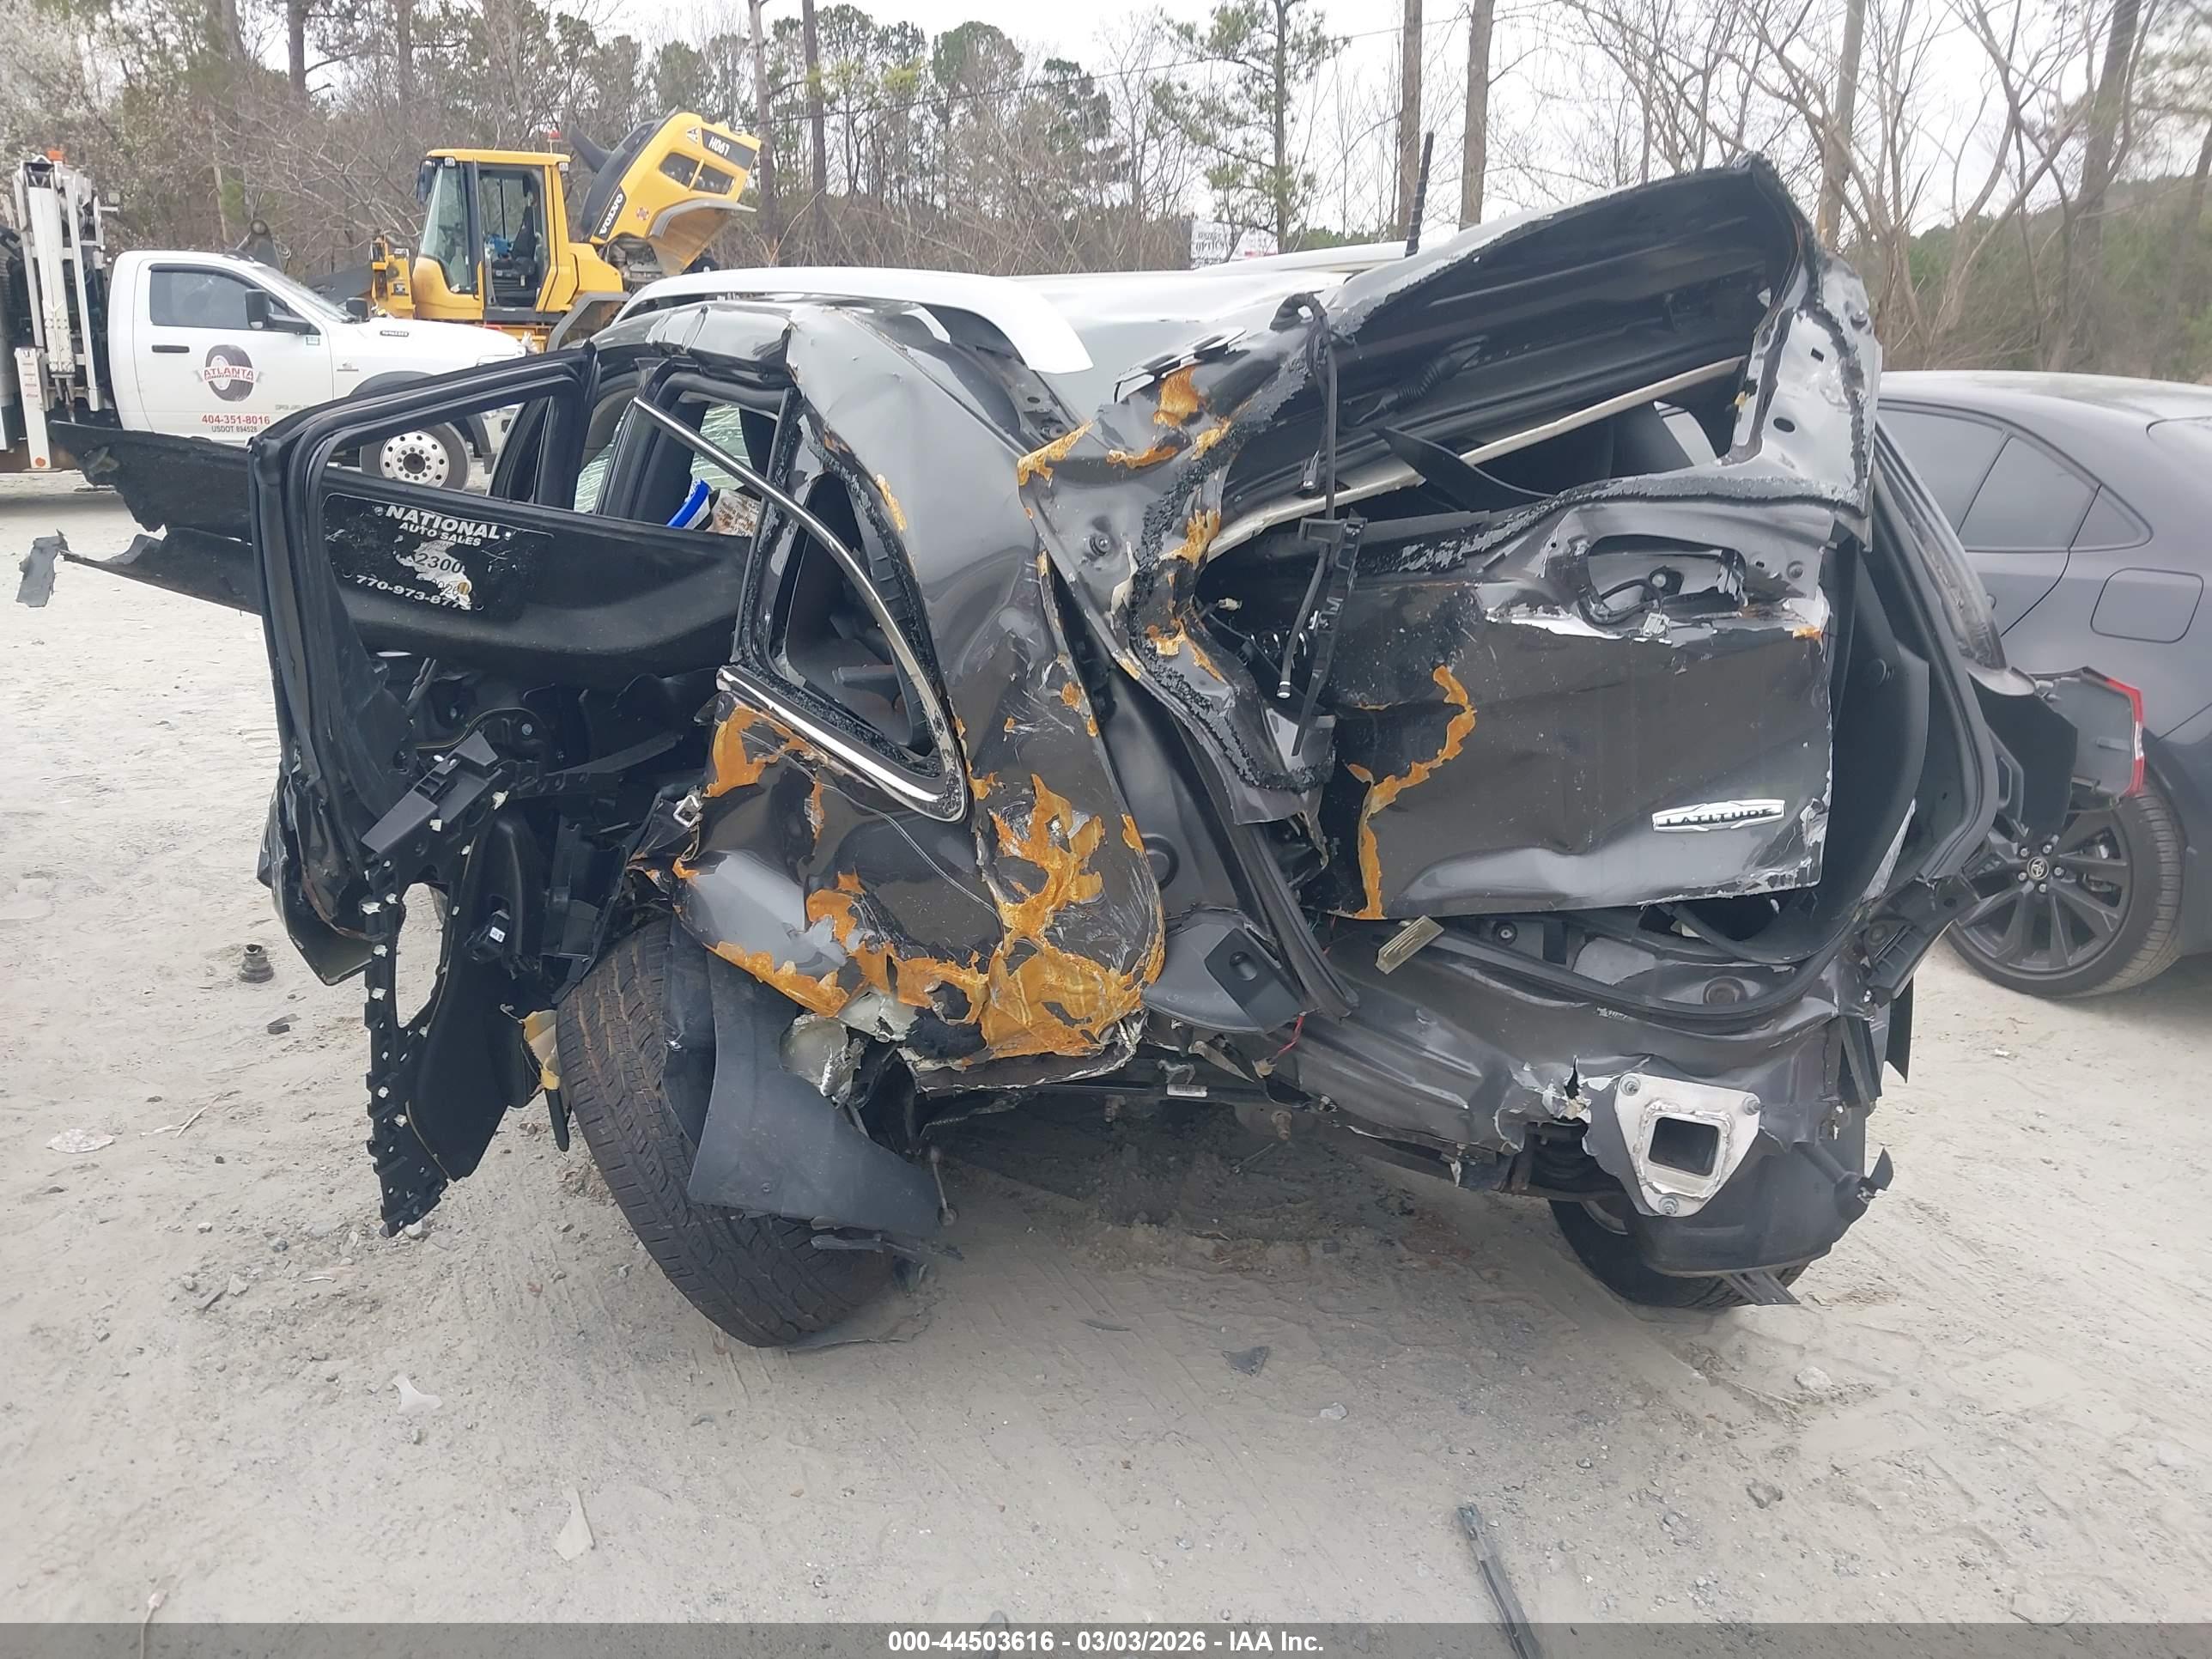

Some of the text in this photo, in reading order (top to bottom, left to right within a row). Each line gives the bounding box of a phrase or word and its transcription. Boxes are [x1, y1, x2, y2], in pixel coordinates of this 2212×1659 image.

[599, 193, 623, 235] VOLVO
[204, 367, 254, 380] ATLANTA
[202, 415, 270, 425] 404-351-8016
[386, 505, 501, 539] NATIONAL
[398, 522, 437, 538] AUTO
[440, 532, 482, 547] SALES
[1666, 807, 1775, 826] LATITUDE
